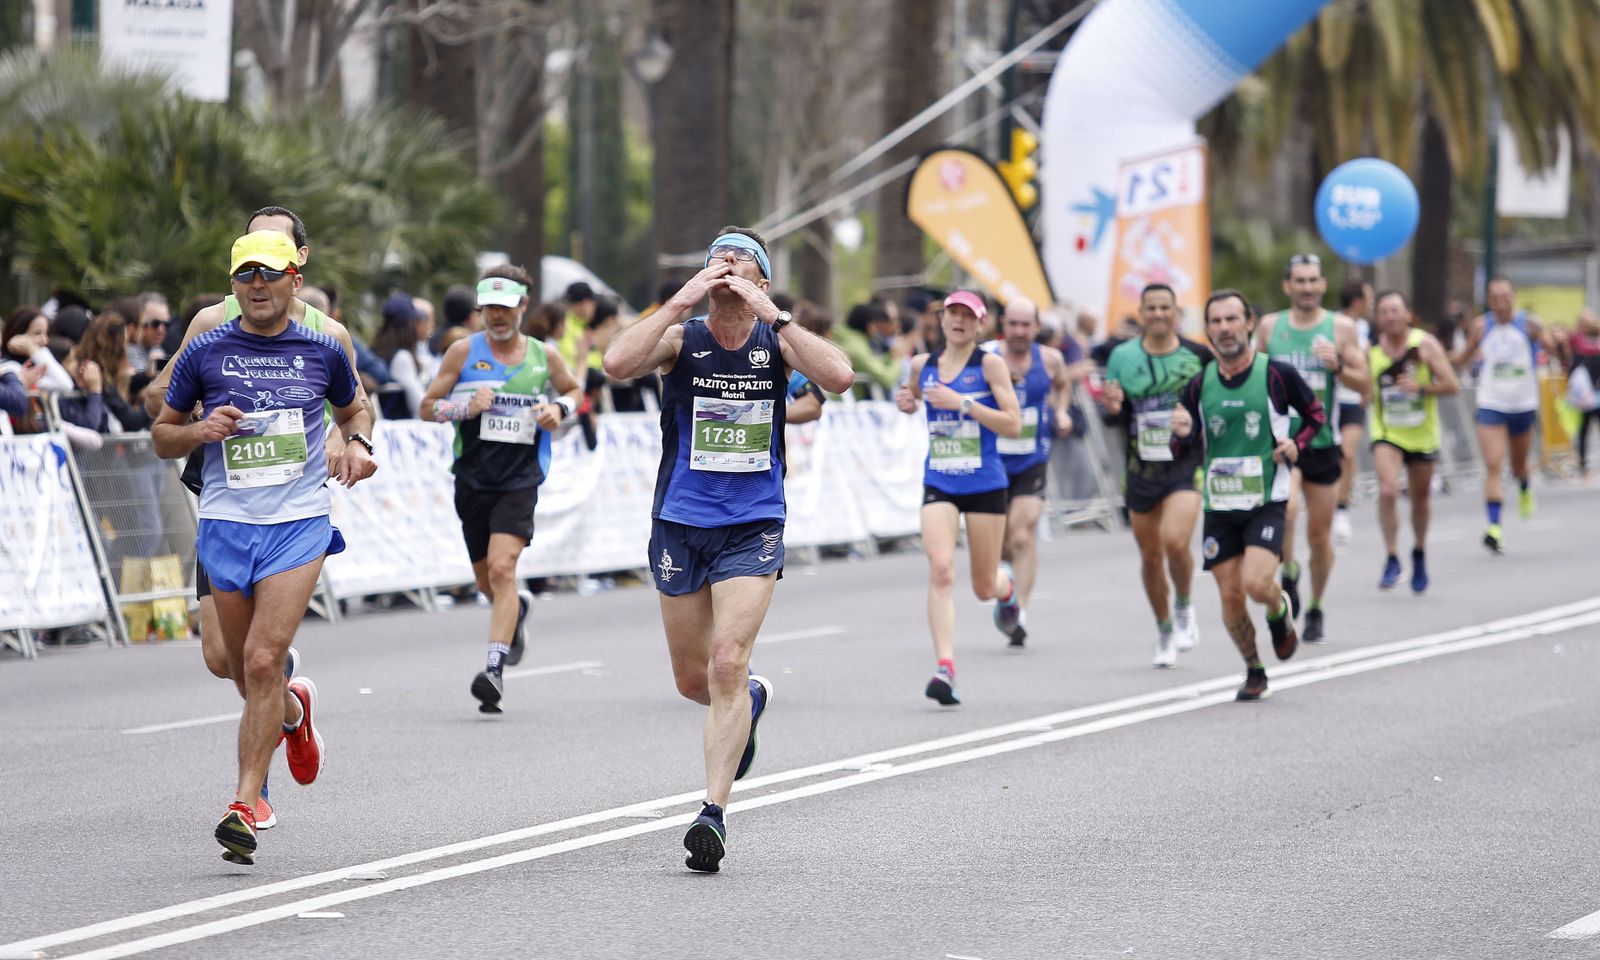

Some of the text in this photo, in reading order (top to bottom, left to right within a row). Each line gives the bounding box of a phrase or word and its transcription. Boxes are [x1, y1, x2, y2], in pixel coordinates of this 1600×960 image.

[752, 350, 767, 361] 30
[692, 377, 728, 390] PAZITO
[738, 381, 773, 391] PAZITO
[721, 391, 746, 399] Motril
[488, 419, 520, 432] 9348
[702, 426, 746, 445] 1738
[231, 441, 276, 461] 2101
